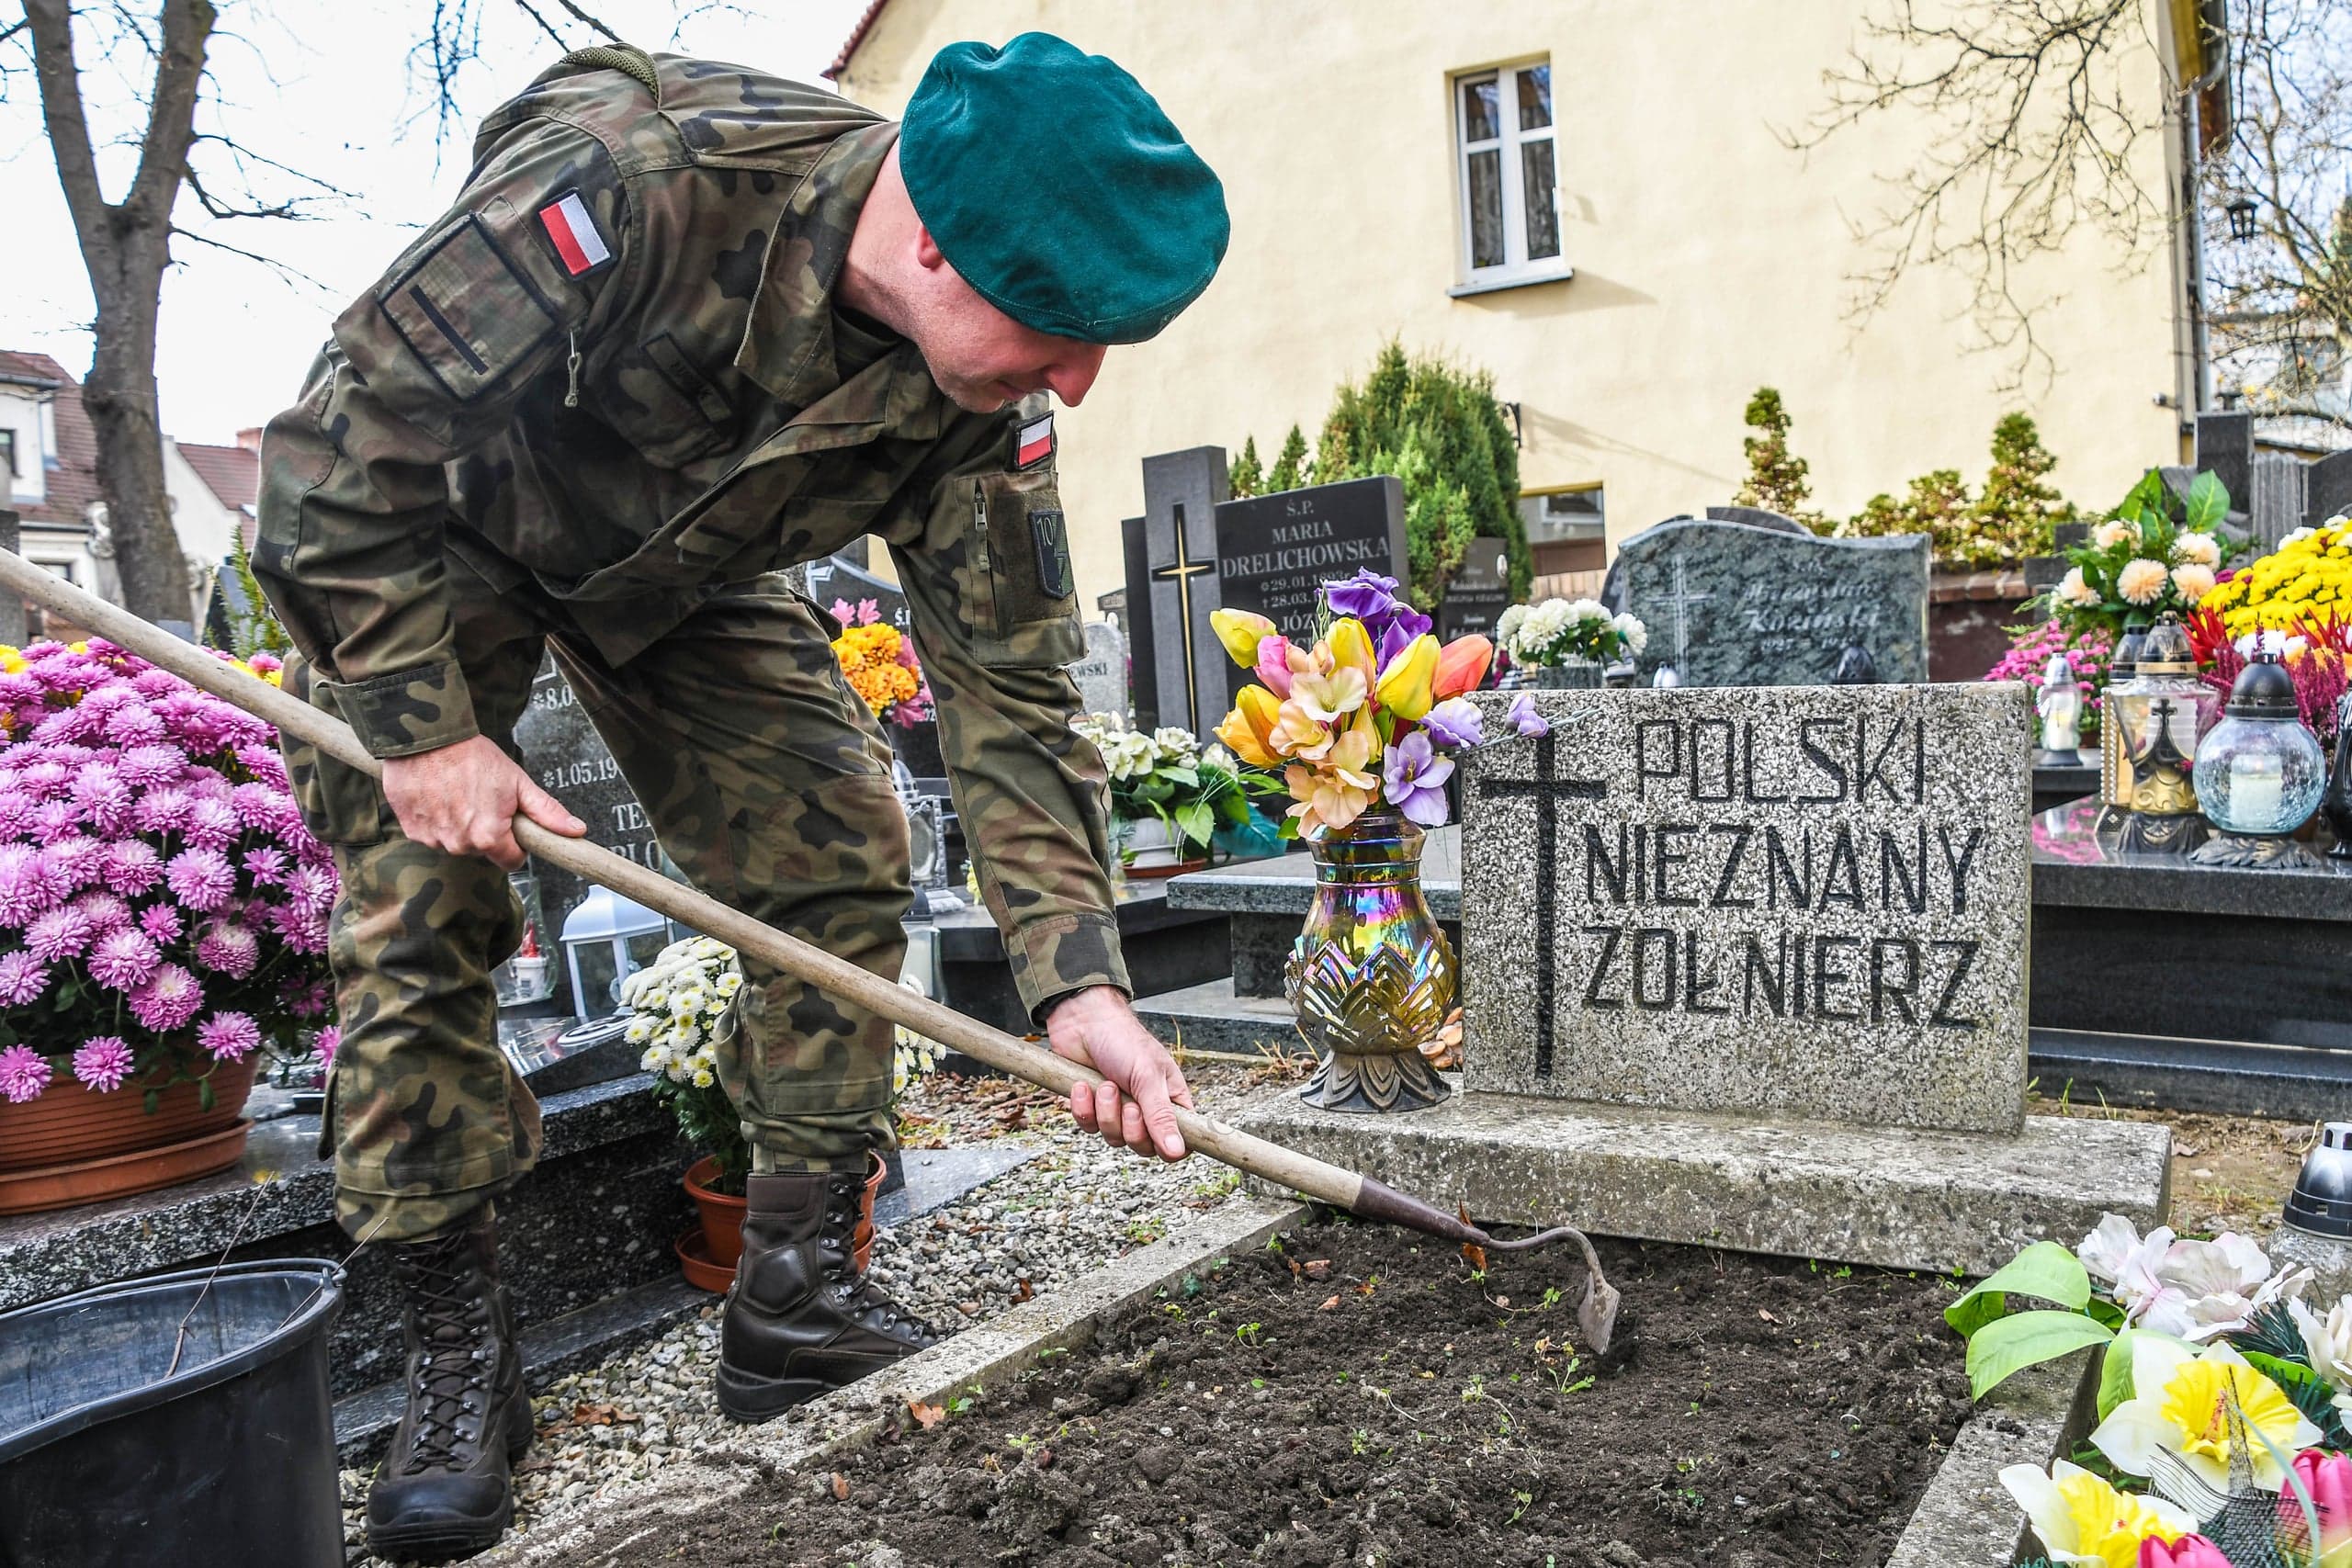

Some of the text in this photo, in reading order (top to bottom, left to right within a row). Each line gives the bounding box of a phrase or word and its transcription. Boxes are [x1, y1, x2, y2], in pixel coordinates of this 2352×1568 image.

[1286, 499, 1315, 517] Ś.P.
[1036, 516, 1054, 547] 10
[1272, 521, 1333, 545] MARIA
[1222, 536, 1391, 578] DRELICHOWSKA
[1281, 609, 1319, 633] JÓZ
[556, 756, 619, 788] 1.05.19
[1635, 714, 1924, 805] POLSKI
[611, 802, 652, 832] TE
[1585, 822, 1983, 916] NIEZNANY
